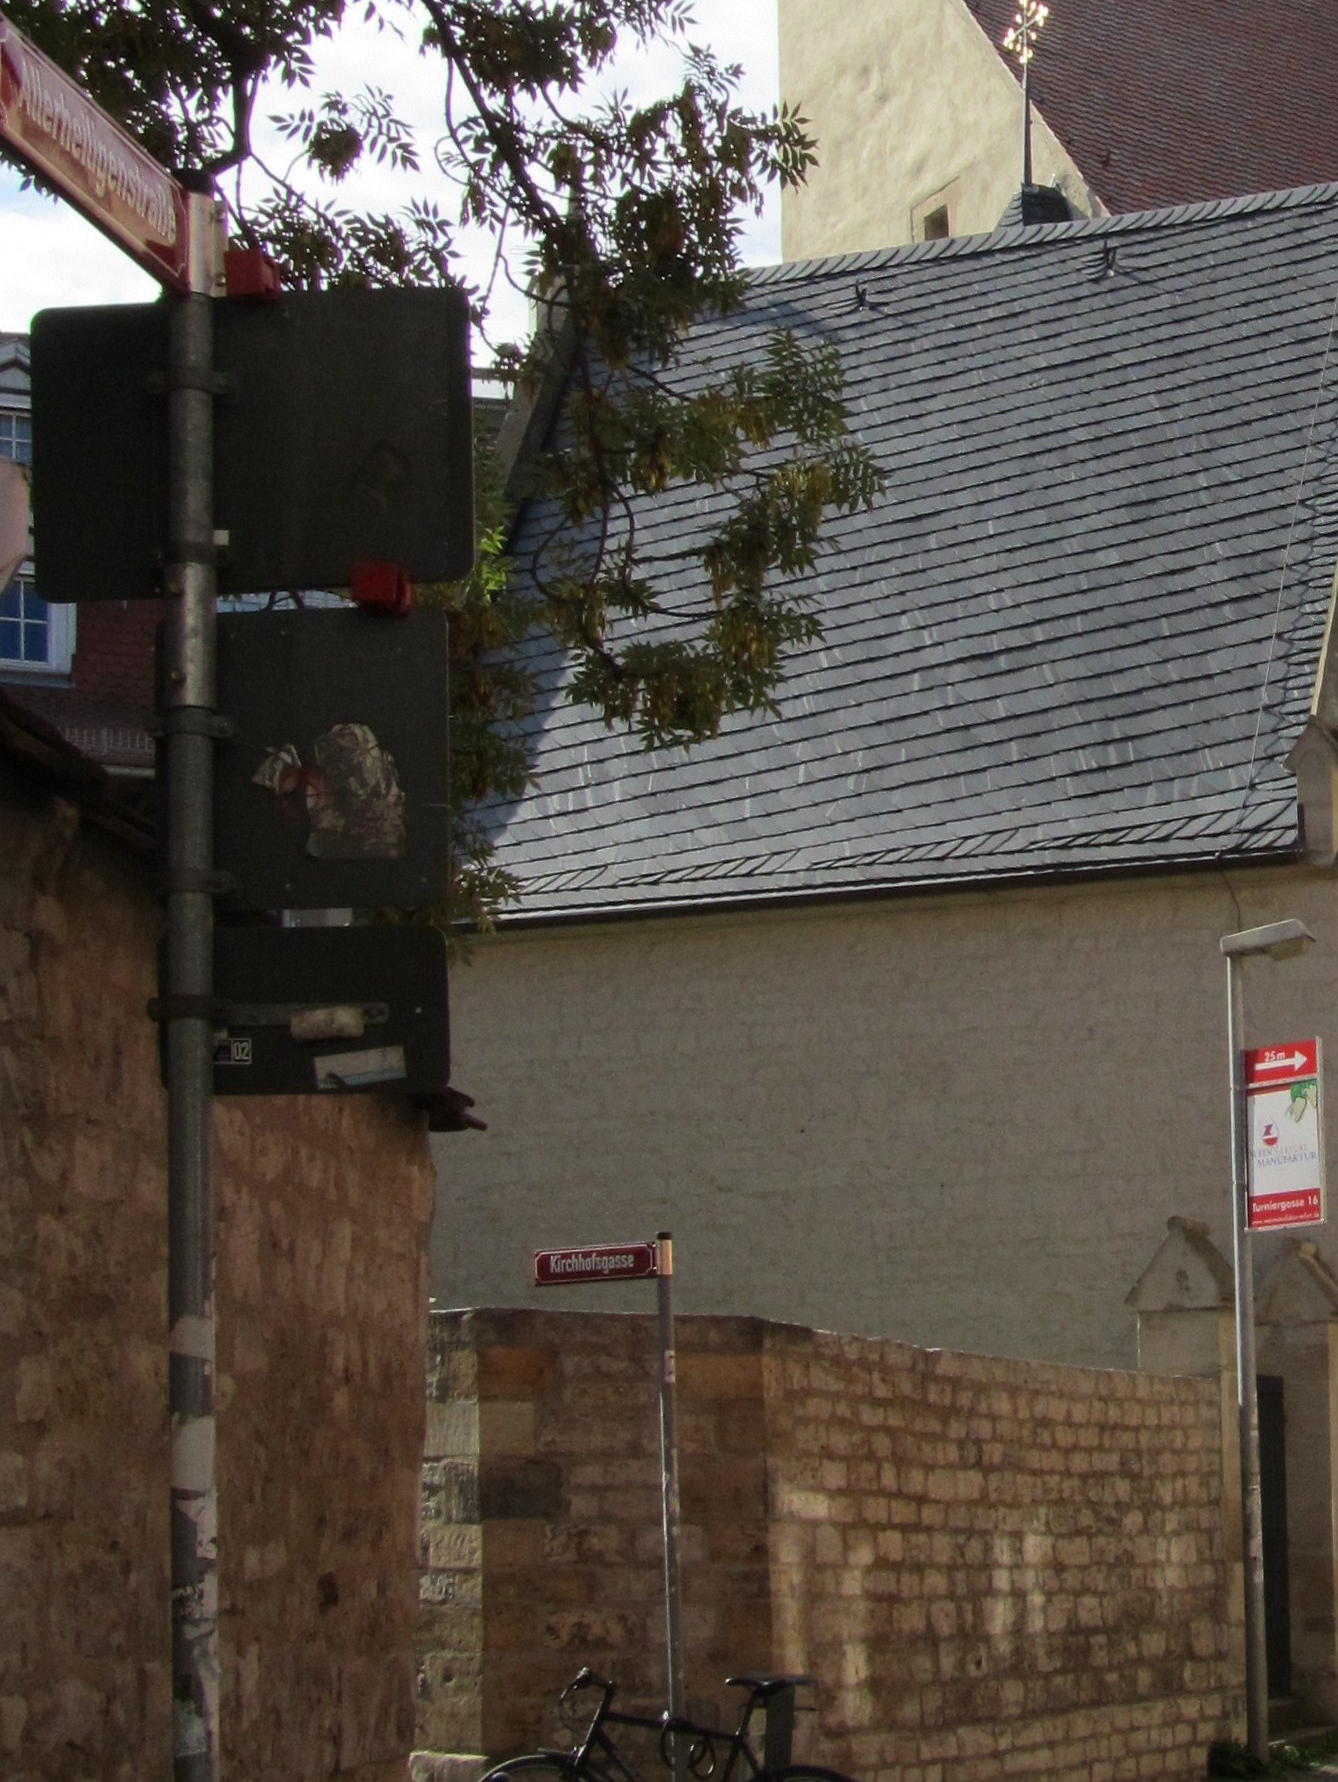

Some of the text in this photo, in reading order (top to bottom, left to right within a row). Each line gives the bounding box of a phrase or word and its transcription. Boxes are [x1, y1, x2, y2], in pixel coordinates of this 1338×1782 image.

[18, 54, 177, 244] Allerheiligenstraße
[234, 1041, 250, 1060] 02
[1264, 1050, 1286, 1062] 25 m
[1256, 1151, 1318, 1167] MANUFAKTUR
[1252, 1195, 1319, 1213] Turniergasse 16
[550, 1252, 635, 1275] Kirchhofsgasse
